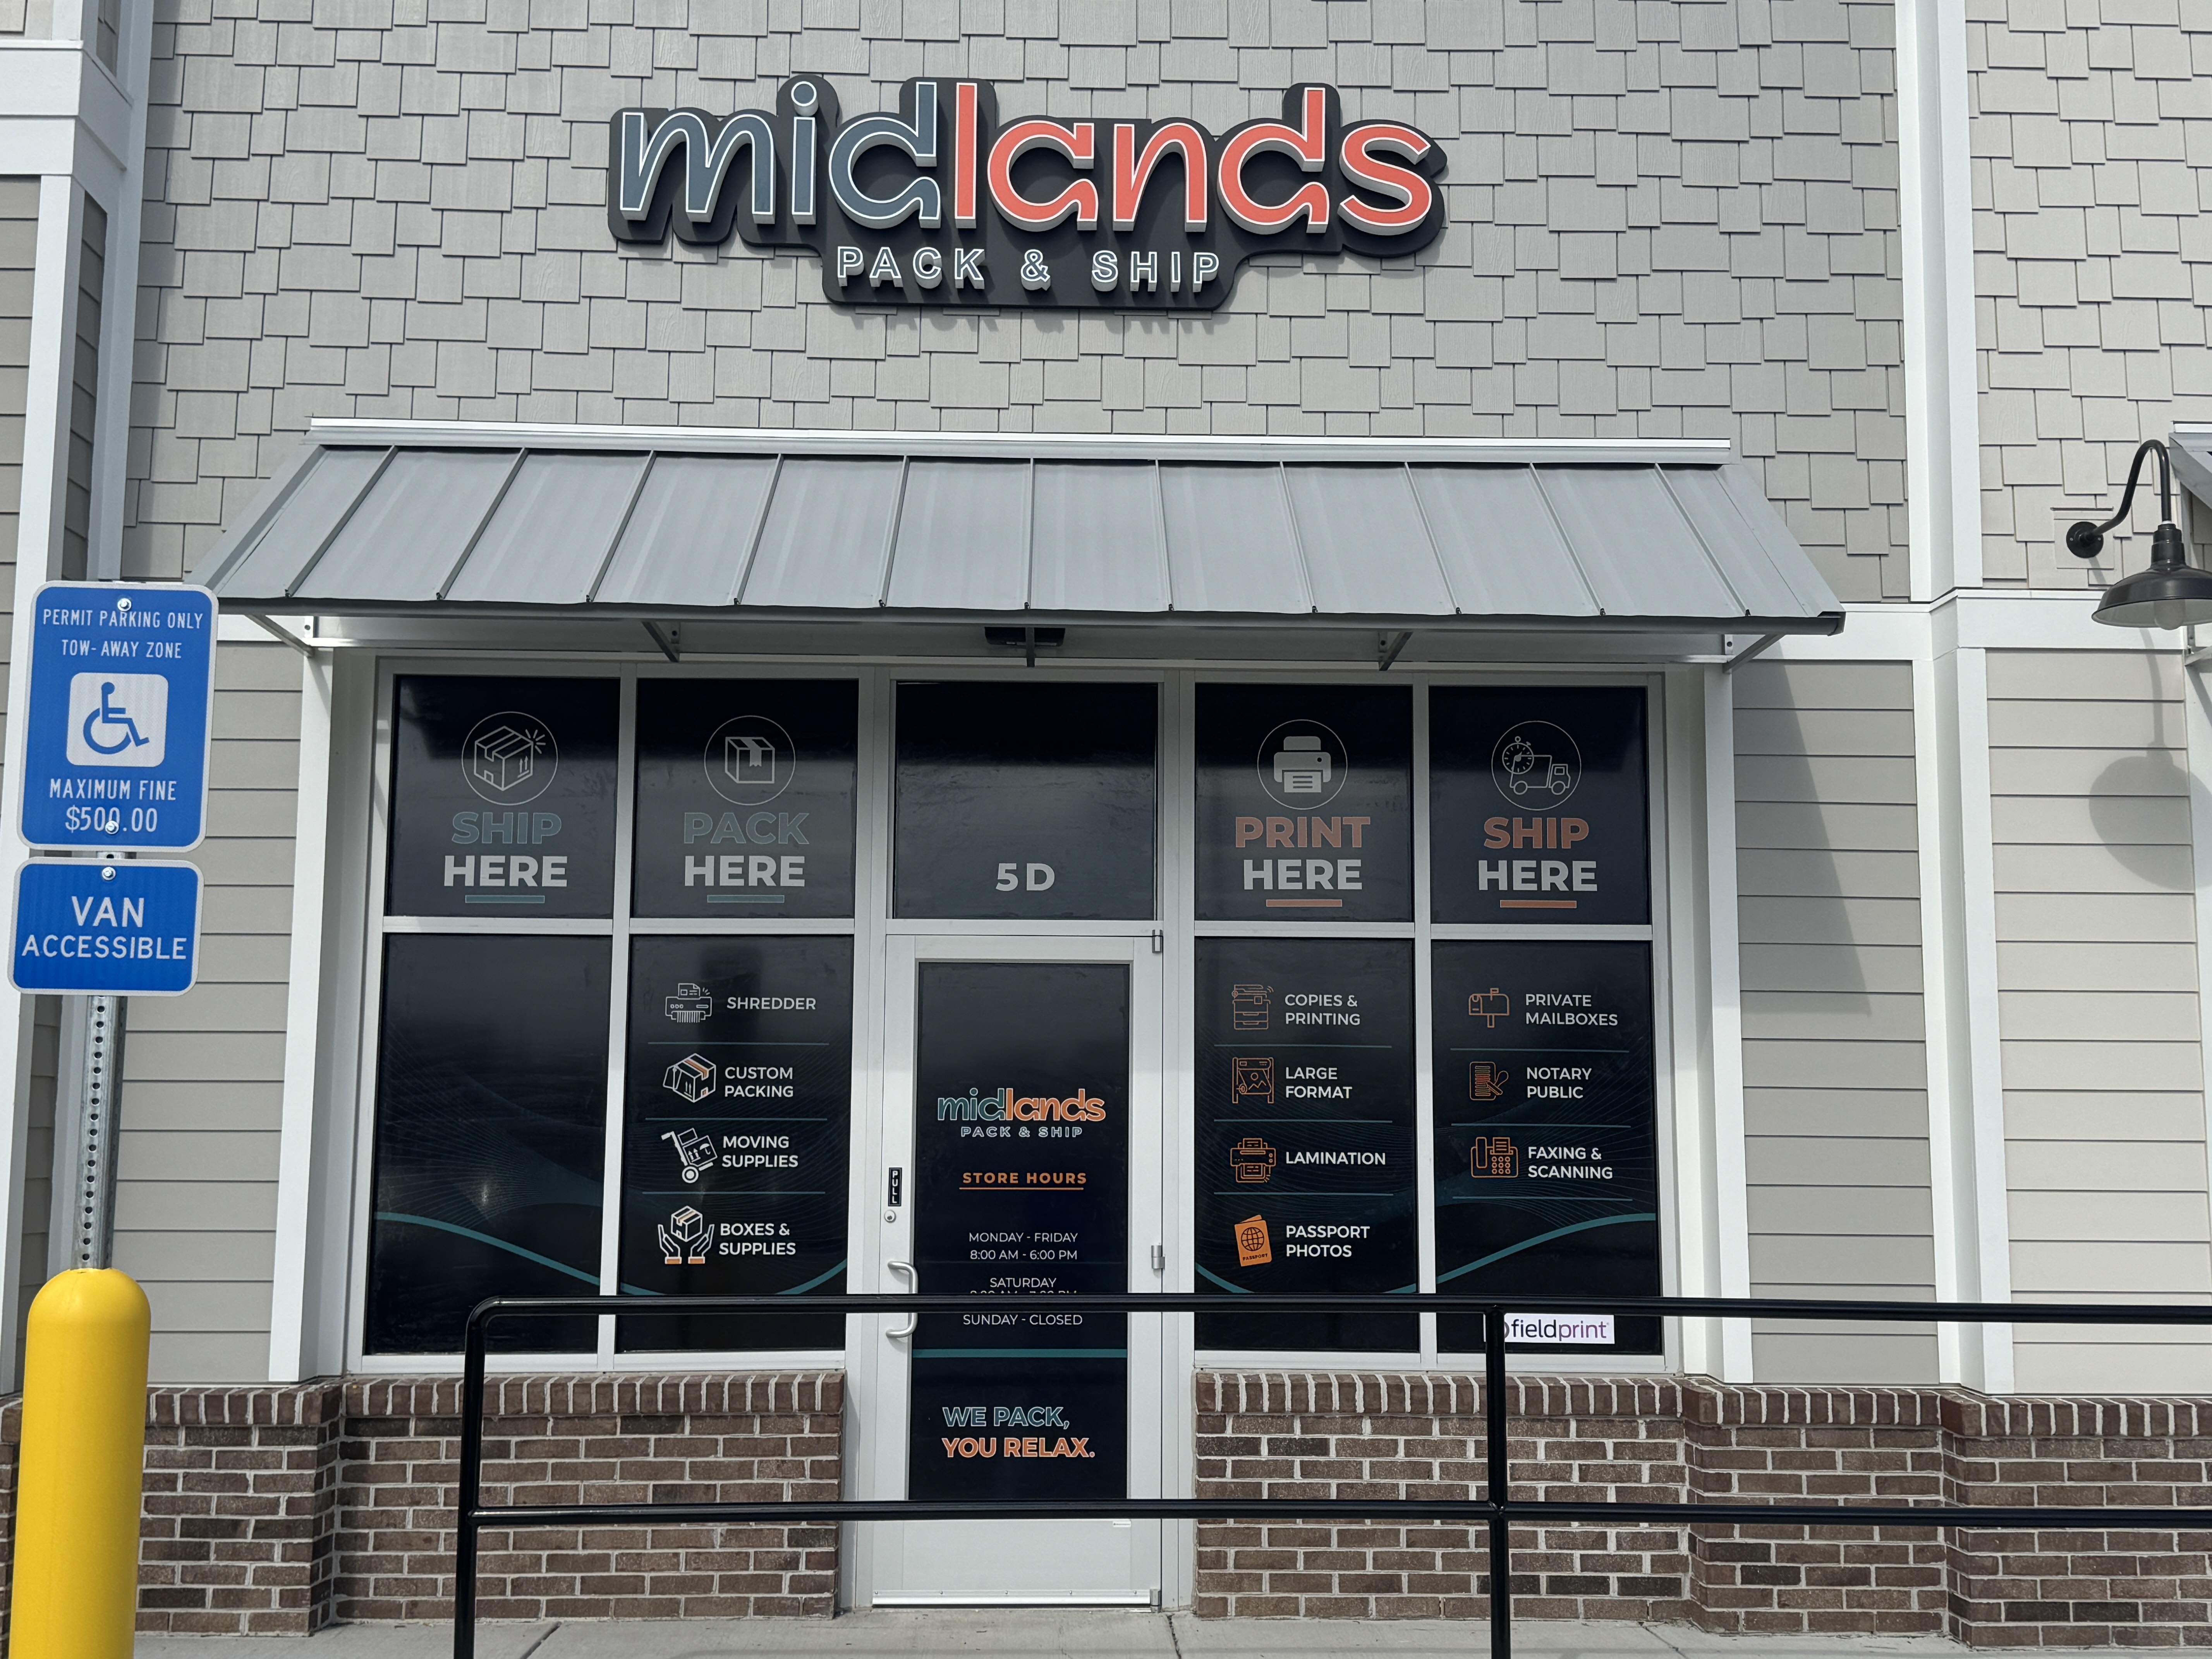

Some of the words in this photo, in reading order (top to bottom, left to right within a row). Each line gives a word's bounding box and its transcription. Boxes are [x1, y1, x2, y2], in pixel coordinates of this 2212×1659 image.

[620, 81, 1432, 232] midlands
[837, 247, 984, 289] PACK
[1021, 249, 1050, 289] &
[1092, 250, 1218, 291] SHIP
[43, 609, 93, 626] PERMIT
[100, 611, 160, 628] PARKING
[167, 613, 203, 629] ONLY
[146, 642, 182, 658] ZONE
[50, 778, 131, 800] MAXIMUM
[139, 780, 177, 800] FINE
[65, 804, 158, 833] $500.00
[452, 812, 562, 844] SHIP
[684, 813, 809, 845] PACK
[1235, 816, 1371, 848] PRINT
[1483, 817, 1590, 849] SHIP
[444, 856, 567, 887] HERE
[685, 856, 805, 887] HERE
[1243, 859, 1362, 891] HERE
[1479, 860, 1598, 892] HERE
[71, 896, 144, 927] VAN
[22, 935, 187, 960] ACCESSIBLE
[726, 997, 816, 1010] SHREDDER
[1285, 994, 1343, 1006] COPIES
[1347, 995, 1358, 1007] &
[1526, 994, 1592, 1006] PRIVATE
[1285, 1013, 1360, 1025] PRINTING
[1526, 1013, 1618, 1026] MAILBOXES
[725, 1067, 793, 1079] CUSTOM
[1286, 1068, 1338, 1080] LARGE
[1527, 1068, 1592, 1080] NOTARY
[725, 1086, 793, 1097] PACKING
[1286, 1087, 1353, 1098] FORMAT
[1527, 1087, 1583, 1099] PUBLIC
[937, 1088, 1106, 1121] midlands
[961, 1127, 1011, 1137] PACK
[1018, 1127, 1030, 1137] &
[1038, 1127, 1083, 1137] SHIP
[723, 1136, 789, 1148] MOVING
[1286, 1153, 1386, 1165] LAMINATION
[1528, 1147, 1587, 1159] FAXING
[1591, 1148, 1602, 1160] &
[722, 1155, 798, 1168] SUPPLIES
[963, 1173, 1018, 1184] STORE
[1027, 1173, 1087, 1184] HOURS
[1528, 1166, 1613, 1179] SCANNING
[720, 1223, 775, 1235] BOXES
[779, 1224, 790, 1235] &
[1286, 1226, 1370, 1238] PASSPORT
[969, 1233, 1024, 1242] MONDAY
[1034, 1233, 1078, 1242] FRIDAY
[719, 1243, 796, 1255] SUPPLIES
[970, 1250, 996, 1260] 8:00
[999, 1250, 1018, 1260] AM
[1029, 1250, 1055, 1260] 6:00
[1059, 1250, 1077, 1260] PM
[1286, 1245, 1352, 1257] PHOTOS
[990, 1278, 1057, 1288] SATURDAY
[963, 1315, 1018, 1325] SUNDAY
[1029, 1314, 1083, 1325] CLOSED
[942, 1407, 987, 1427] WE
[994, 1407, 1070, 1430] PACK,
[941, 1437, 997, 1458] YOU
[1004, 1437, 1095, 1458] RELAX.
